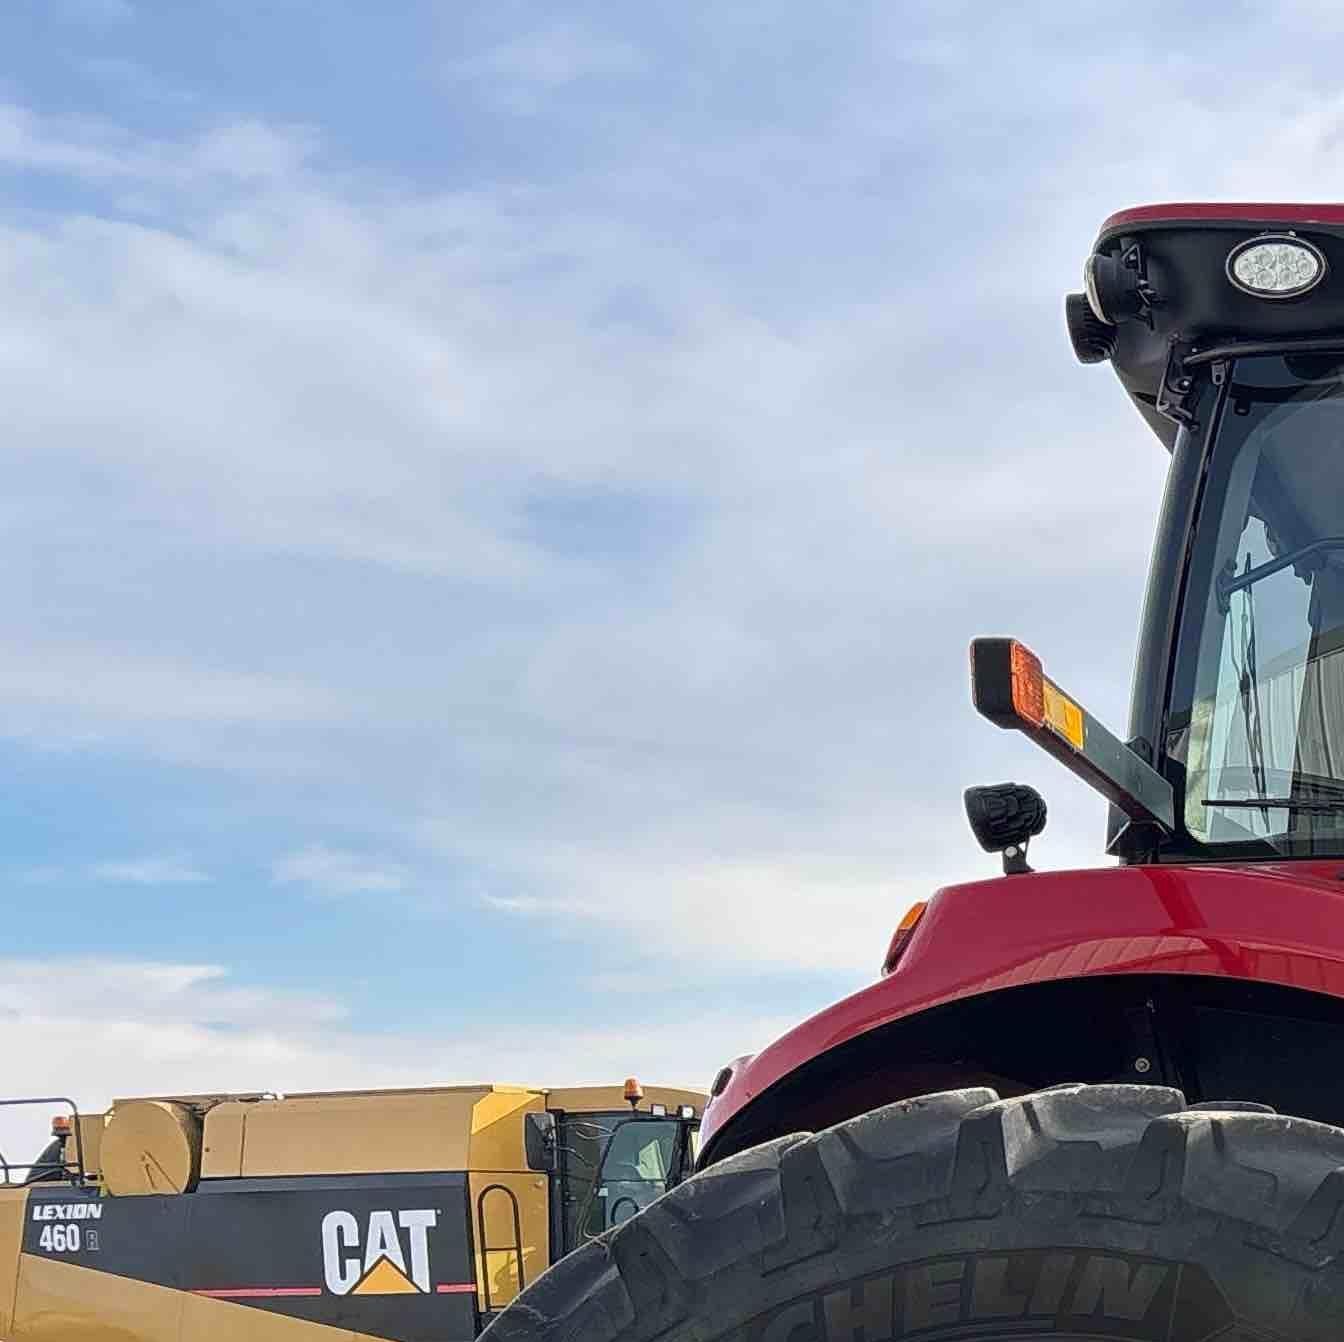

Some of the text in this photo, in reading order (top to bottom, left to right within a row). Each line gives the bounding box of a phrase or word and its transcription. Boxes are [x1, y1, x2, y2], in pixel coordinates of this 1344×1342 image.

[33, 1203, 102, 1220] LEXION
[40, 1224, 80, 1251] 460
[322, 1209, 437, 1295] CAT
